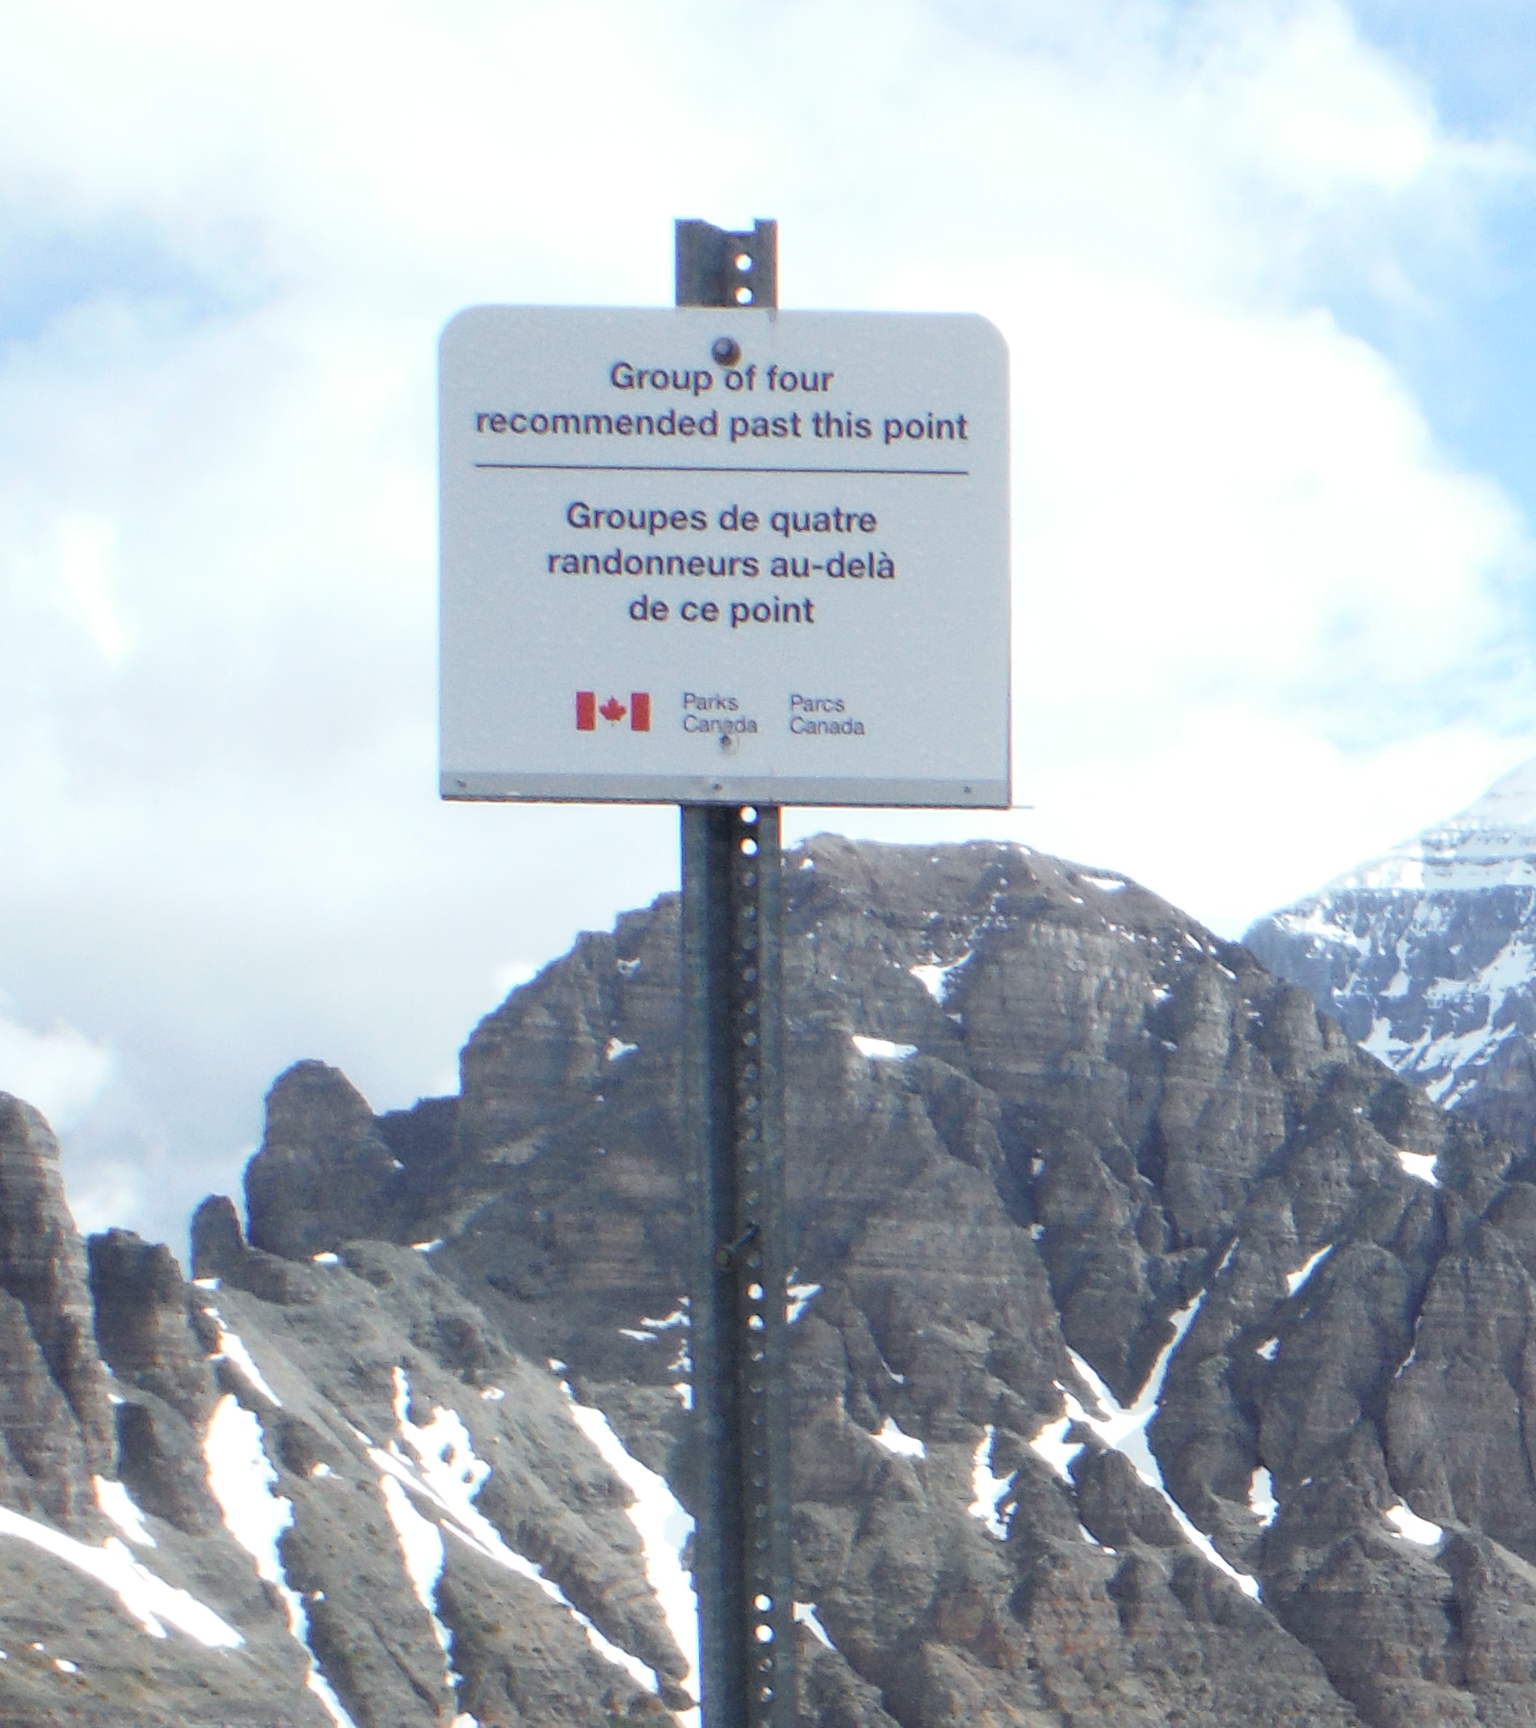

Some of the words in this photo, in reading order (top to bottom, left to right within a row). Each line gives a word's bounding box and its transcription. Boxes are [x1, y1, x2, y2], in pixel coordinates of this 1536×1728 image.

[610, 362, 714, 396] Group
[724, 365, 757, 393] of
[767, 365, 835, 393] four
[475, 410, 718, 438] recommended
[729, 416, 801, 444] past
[811, 413, 873, 440] this
[883, 413, 969, 445] point
[565, 502, 708, 536] Groupes
[718, 505, 759, 533] de
[770, 509, 878, 537] quatre
[547, 550, 760, 578] randonneurs
[769, 552, 896, 580] au-delà
[628, 595, 670, 622] de
[680, 602, 719, 623] ce
[730, 596, 816, 628] point
[682, 693, 740, 712] Parks
[789, 694, 846, 714] Parcs
[682, 715, 759, 735] Canada
[789, 717, 866, 738] Canada
